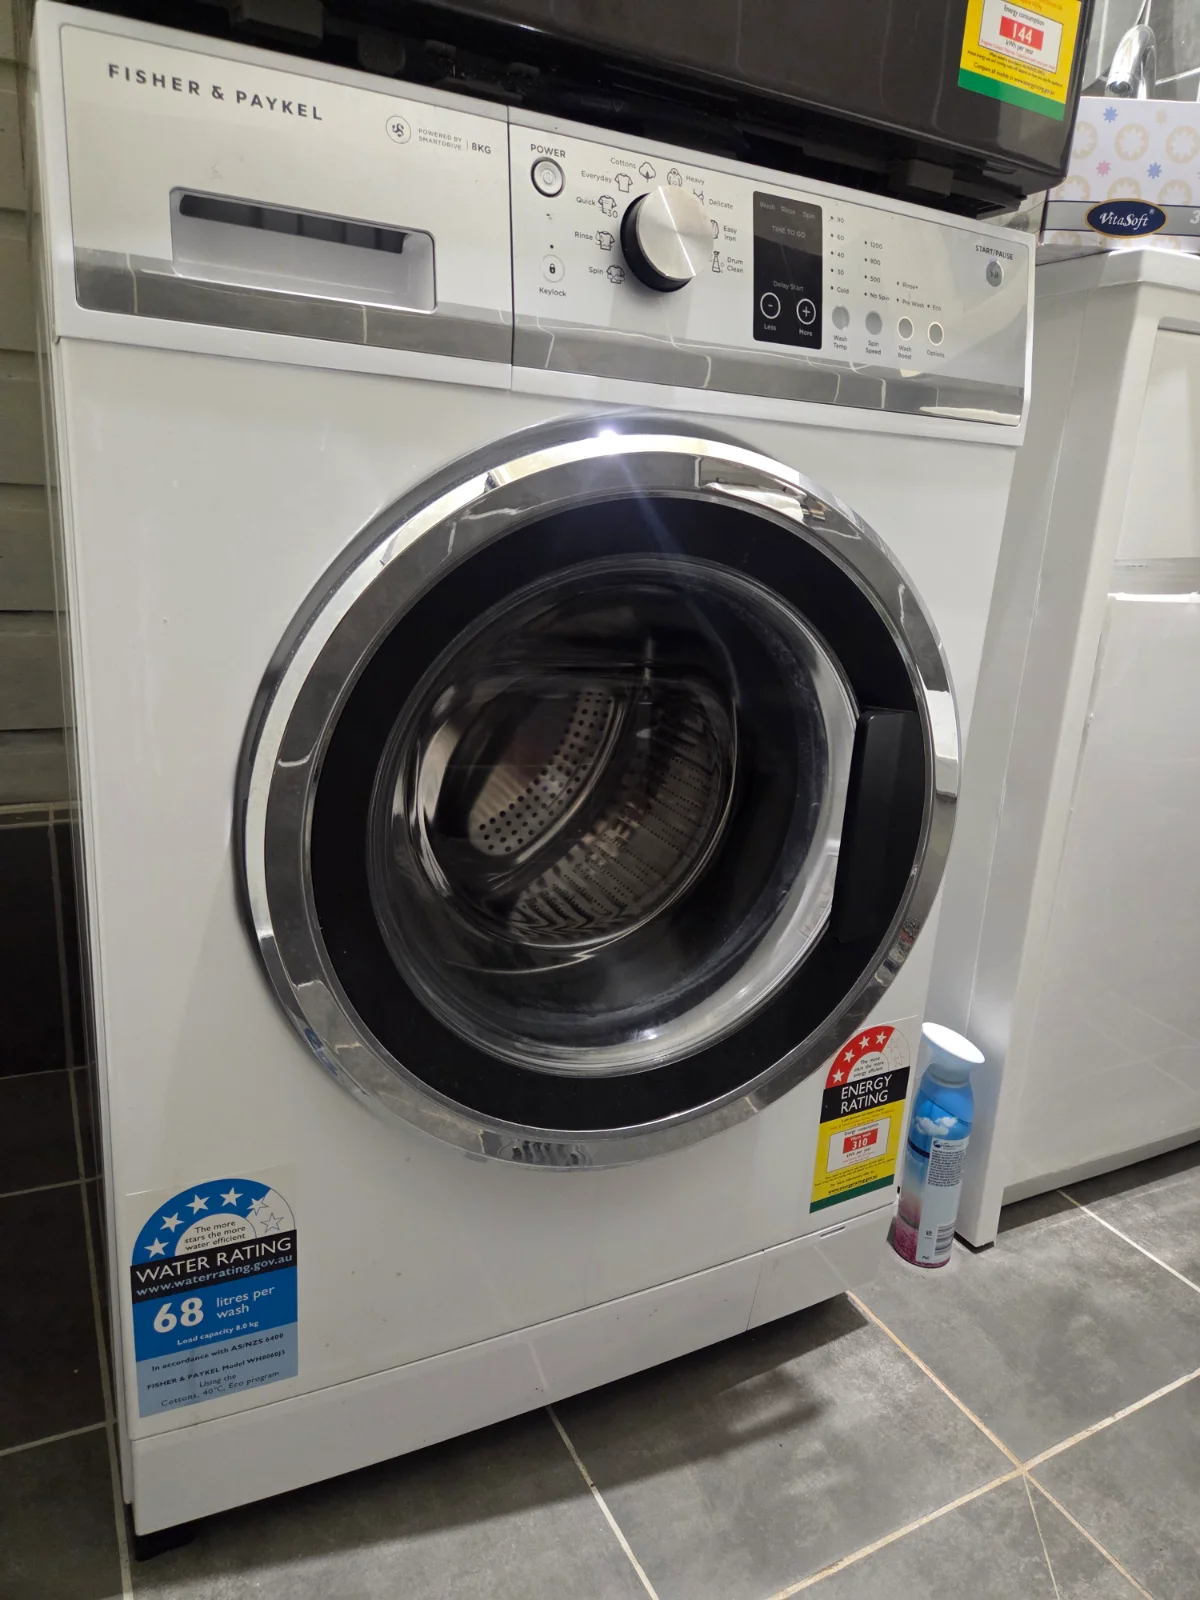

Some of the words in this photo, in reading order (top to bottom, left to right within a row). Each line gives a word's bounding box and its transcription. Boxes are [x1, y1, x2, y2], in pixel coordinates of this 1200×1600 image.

[1004, 4, 1018, 17] Energy
[1018, 11, 1044, 26] consumption
[1012, 23, 1032, 44] 144
[1006, 39, 1016, 48] kWh
[107, 63, 201, 96] FISHER
[211, 85, 225, 100] &
[236, 90, 323, 121] PAYKEL
[418, 128, 452, 141] POWERED
[418, 135, 462, 150] SMARTDRIVE
[470, 142, 492, 155] 8KG
[530, 144, 566, 158] POWER
[610, 158, 636, 170] Cottons
[581, 170, 612, 184] Everyday
[686, 175, 705, 186] Heavy
[576, 196, 596, 206] Quick
[708, 198, 734, 210] Delicate
[760, 201, 776, 211] Wash
[607, 208, 618, 218] 30
[1100, 212, 1148, 230] VitaSoft
[574, 232, 594, 241] Rinse
[723, 225, 737, 235] Easy
[772, 225, 786, 234] TIME
[787, 228, 795, 236] TO
[724, 234, 736, 242] Iron
[870, 242, 882, 250] 1200
[976, 245, 1014, 260] START/PAUSE
[727, 257, 743, 266] Drum
[870, 258, 880, 266] 800
[588, 266, 604, 276] Spin
[727, 265, 744, 274] Clean
[539, 287, 566, 298] Keylock
[773, 280, 790, 291] Delay
[790, 284, 804, 292] Start
[833, 342, 847, 350] Temp
[866, 348, 882, 356] Speed
[926, 350, 945, 358] Options
[841, 1074, 892, 1100] ENERGY
[840, 1090, 888, 1114] RATING
[852, 1138, 868, 1150] 310
[214, 1221, 236, 1230] more
[184, 1236, 205, 1244] stars
[224, 1226, 246, 1234] more
[186, 1242, 210, 1250] water
[212, 1234, 246, 1245] efficient
[136, 1256, 210, 1284] WATER
[216, 1236, 292, 1266] RATING
[136, 1254, 293, 1296] www.waterrating.gov.au
[216, 1292, 249, 1308] litres
[252, 1286, 276, 1302] per
[153, 1296, 204, 1333] 68
[216, 1303, 250, 1320] wash
[177, 1336, 198, 1346] Load
[200, 1328, 234, 1340] capacity
[162, 1353, 208, 1368] accordance
[211, 1348, 229, 1356] with
[230, 1338, 264, 1351] AS/NZS
[265, 1333, 284, 1342] 6400
[147, 1377, 178, 1390] FISHER
[188, 1368, 220, 1380] PAYKEL
[222, 1360, 245, 1370] Model
[200, 1378, 222, 1388] Using
[224, 1374, 236, 1382] the
[246, 1372, 280, 1386] program
